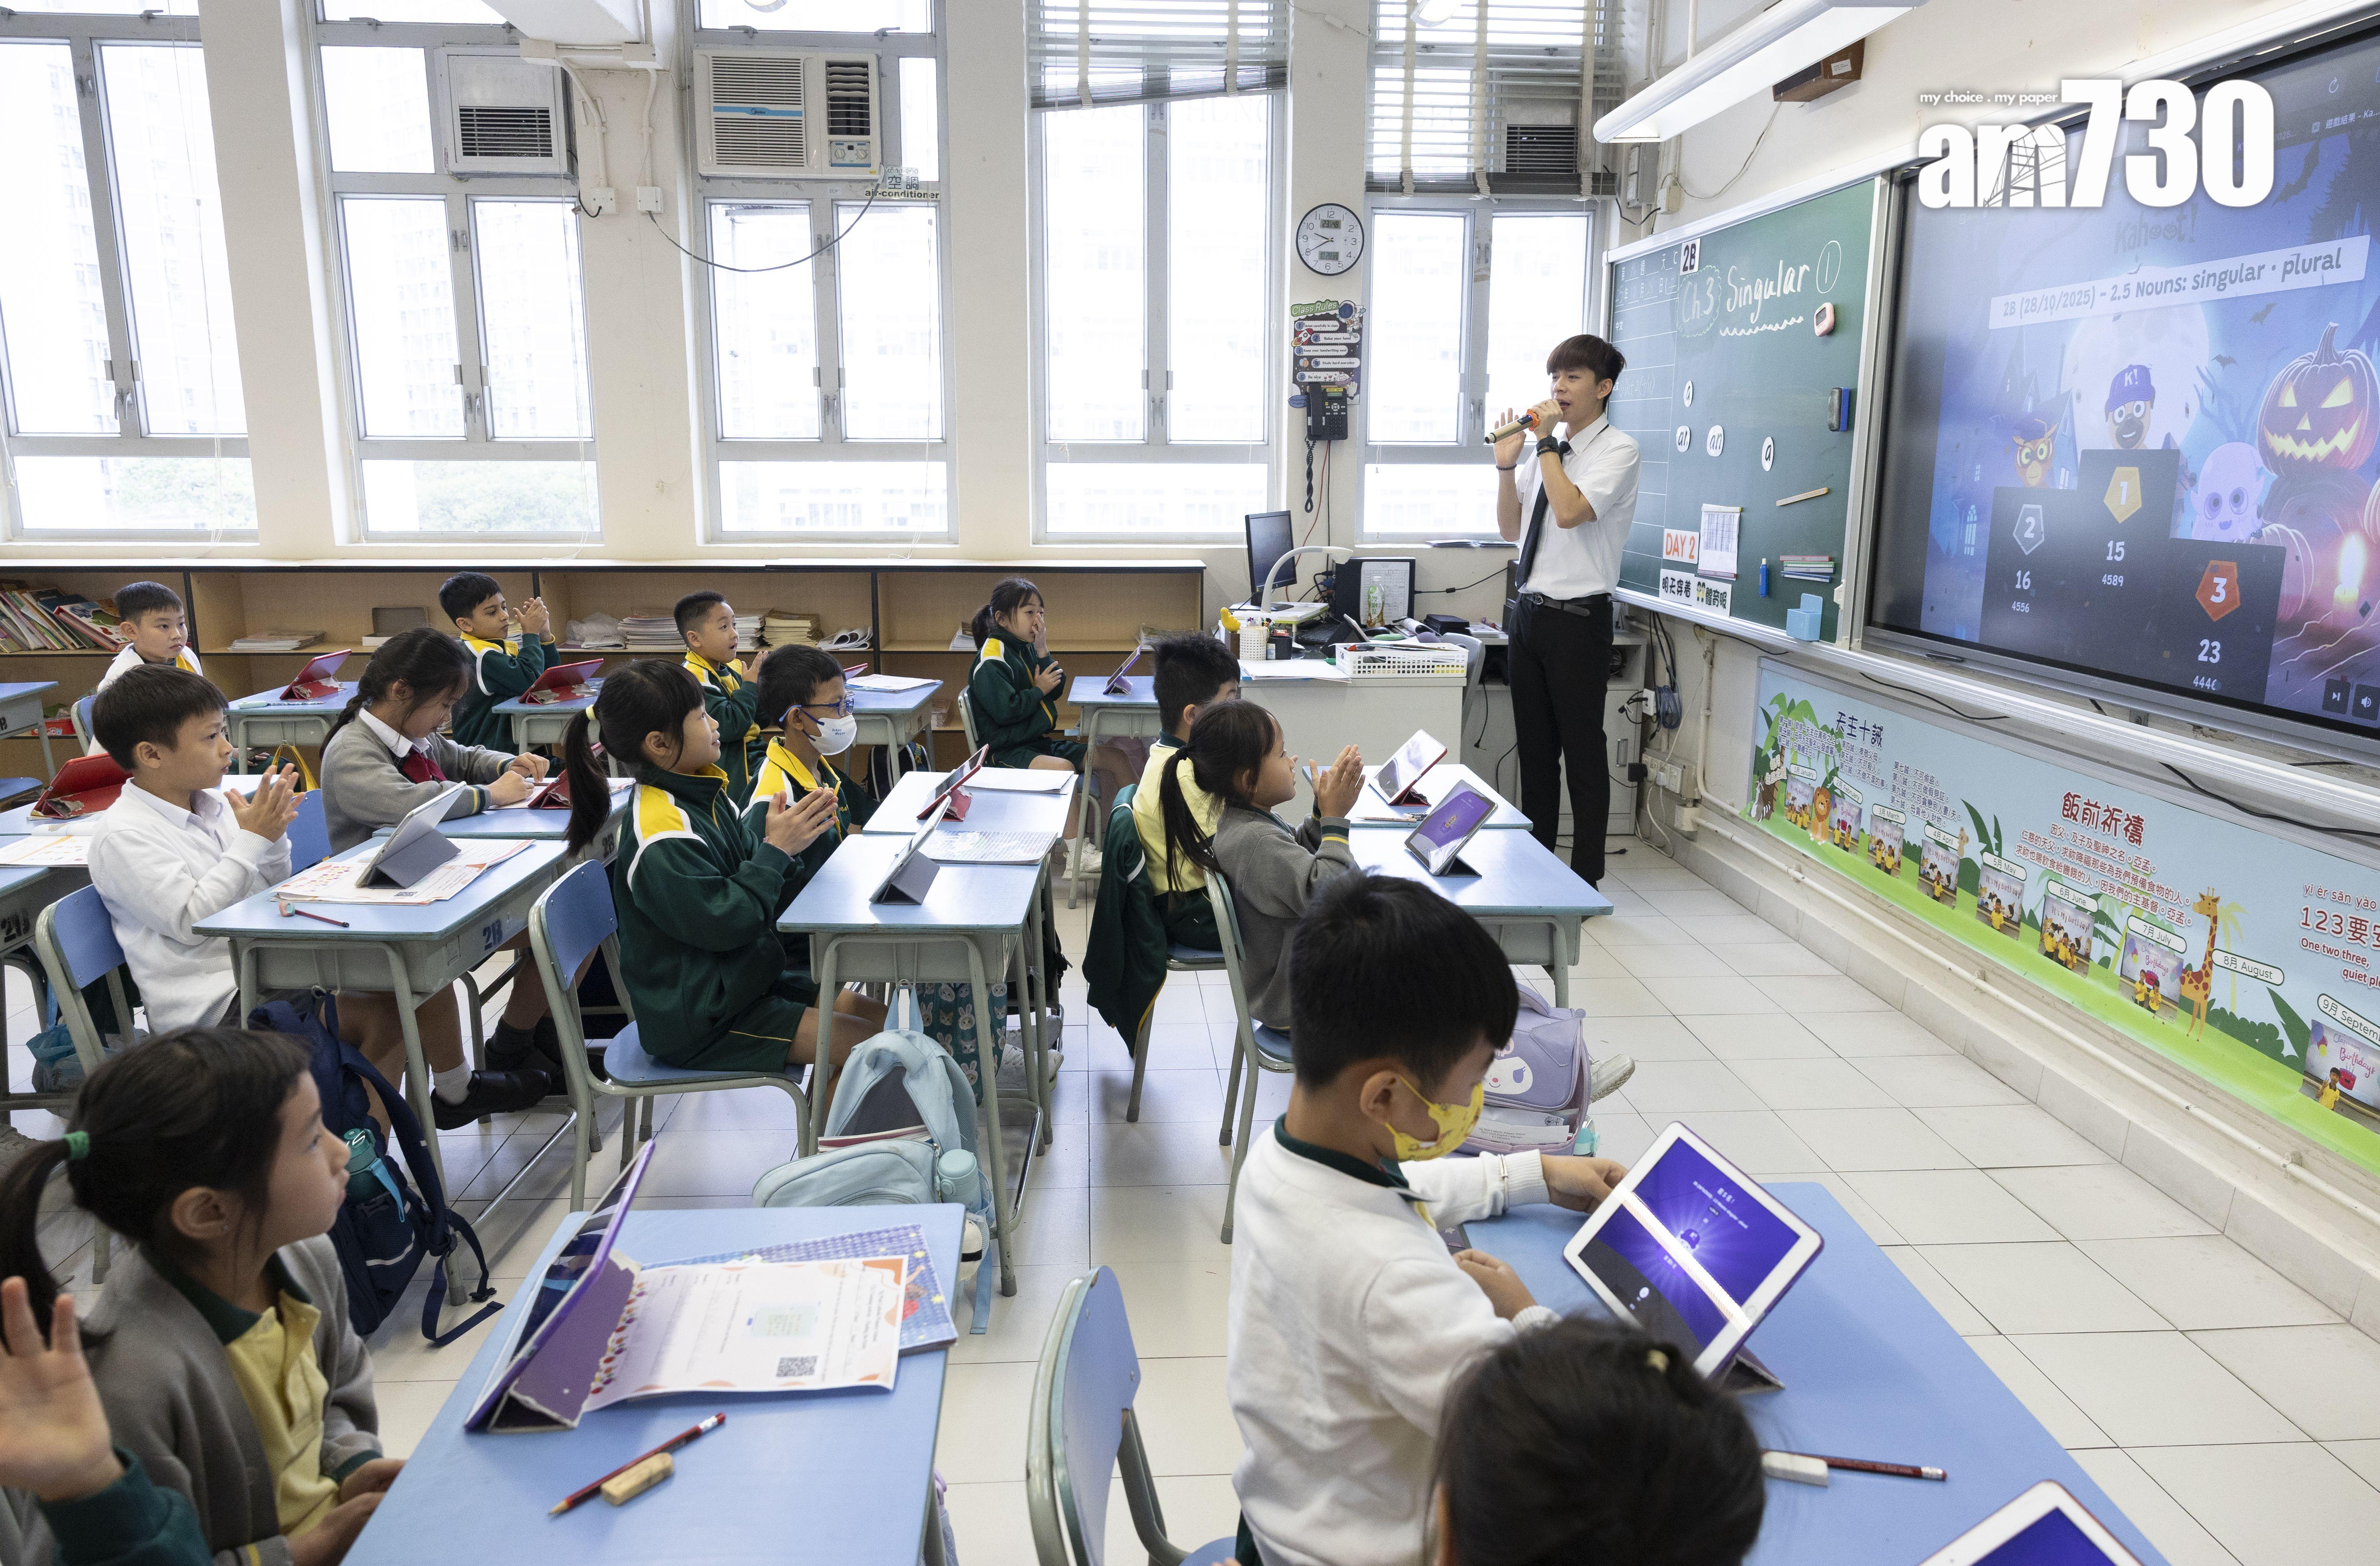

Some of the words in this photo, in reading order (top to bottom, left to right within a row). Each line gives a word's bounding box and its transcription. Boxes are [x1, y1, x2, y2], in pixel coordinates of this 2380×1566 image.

[888, 175, 919, 190] 空調
[865, 189, 939, 199] air-conditioner
[1682, 243, 1697, 272] 2B
[1703, 276, 1715, 315] 3
[1727, 260, 1810, 322] Singular
[2003, 301, 2016, 317] 2B
[2020, 288, 2096, 318] (28/10/2025)
[2110, 282, 2131, 301] 2.5
[2136, 271, 2188, 298] Nouns:
[2191, 260, 2266, 292] singular
[2282, 247, 2342, 283] plural
[1292, 306, 1314, 315] Class
[1316, 301, 1337, 312] Rules
[2124, 368, 2139, 387] K!
[1765, 445, 1771, 462] a
[2119, 481, 2128, 506] 1
[2025, 517, 2035, 538] 2
[1666, 533, 1686, 558] DAY
[1689, 536, 1695, 559] 2
[2106, 540, 2125, 561] 15
[2015, 570, 2031, 590] 16
[2102, 573, 2124, 587] 4589
[2210, 577, 2227, 603] 3
[1706, 587, 1727, 609] 體育服
[2011, 601, 2030, 613] 4556
[2198, 639, 2221, 663] 23
[1836, 711, 1884, 748] 天主十誡
[1800, 770, 1814, 779] January
[1836, 779, 1842, 788] 2月
[1843, 784, 1860, 801] February
[1887, 810, 1900, 820] March
[2063, 792, 2144, 845] 飯前祈禱
[1933, 831, 1941, 840] 4月
[1943, 834, 1953, 845] April
[1993, 858, 2002, 868] 5月
[2004, 863, 2017, 875] May
[2060, 888, 2070, 898] 6月
[2072, 893, 2086, 907] June
[2332, 889, 2351, 903] sān
[2356, 894, 2377, 909] yào
[2143, 924, 2154, 937] 7月
[2156, 931, 2171, 946] July
[2301, 938, 2320, 951] One
[2322, 943, 2340, 956] two
[2342, 948, 2370, 967] three,
[2223, 955, 2237, 968] 8月
[2241, 961, 2273, 980] August
[2342, 968, 2367, 983] quiet
[2323, 998, 2338, 1016] 9月
[2341, 1009, 2380, 1042] Septem
[2340, 1047, 2376, 1078] Birthdays
